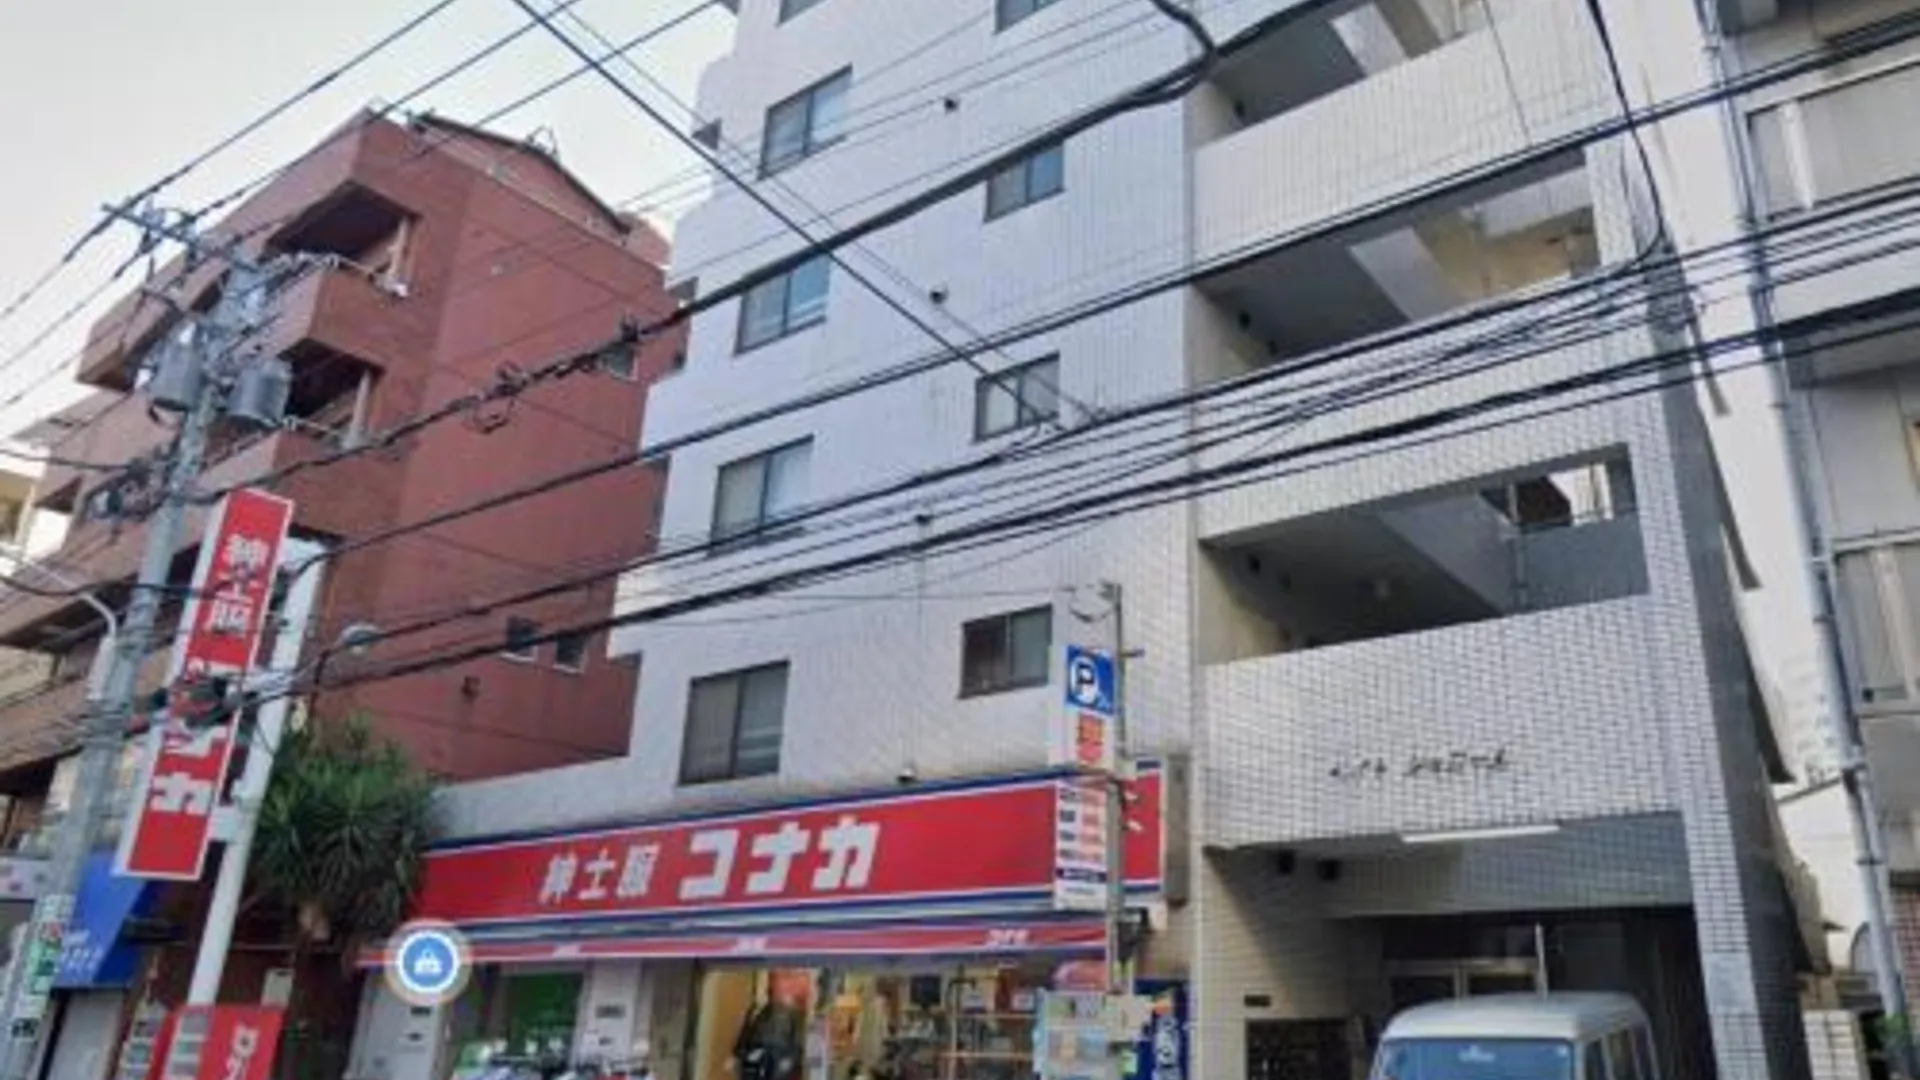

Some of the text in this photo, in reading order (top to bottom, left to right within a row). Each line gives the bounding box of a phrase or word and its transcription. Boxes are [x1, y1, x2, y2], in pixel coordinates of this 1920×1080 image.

[150, 532, 269, 816] 紳士服 ナカ
[538, 814, 880, 905] 紳士服 コナカ
